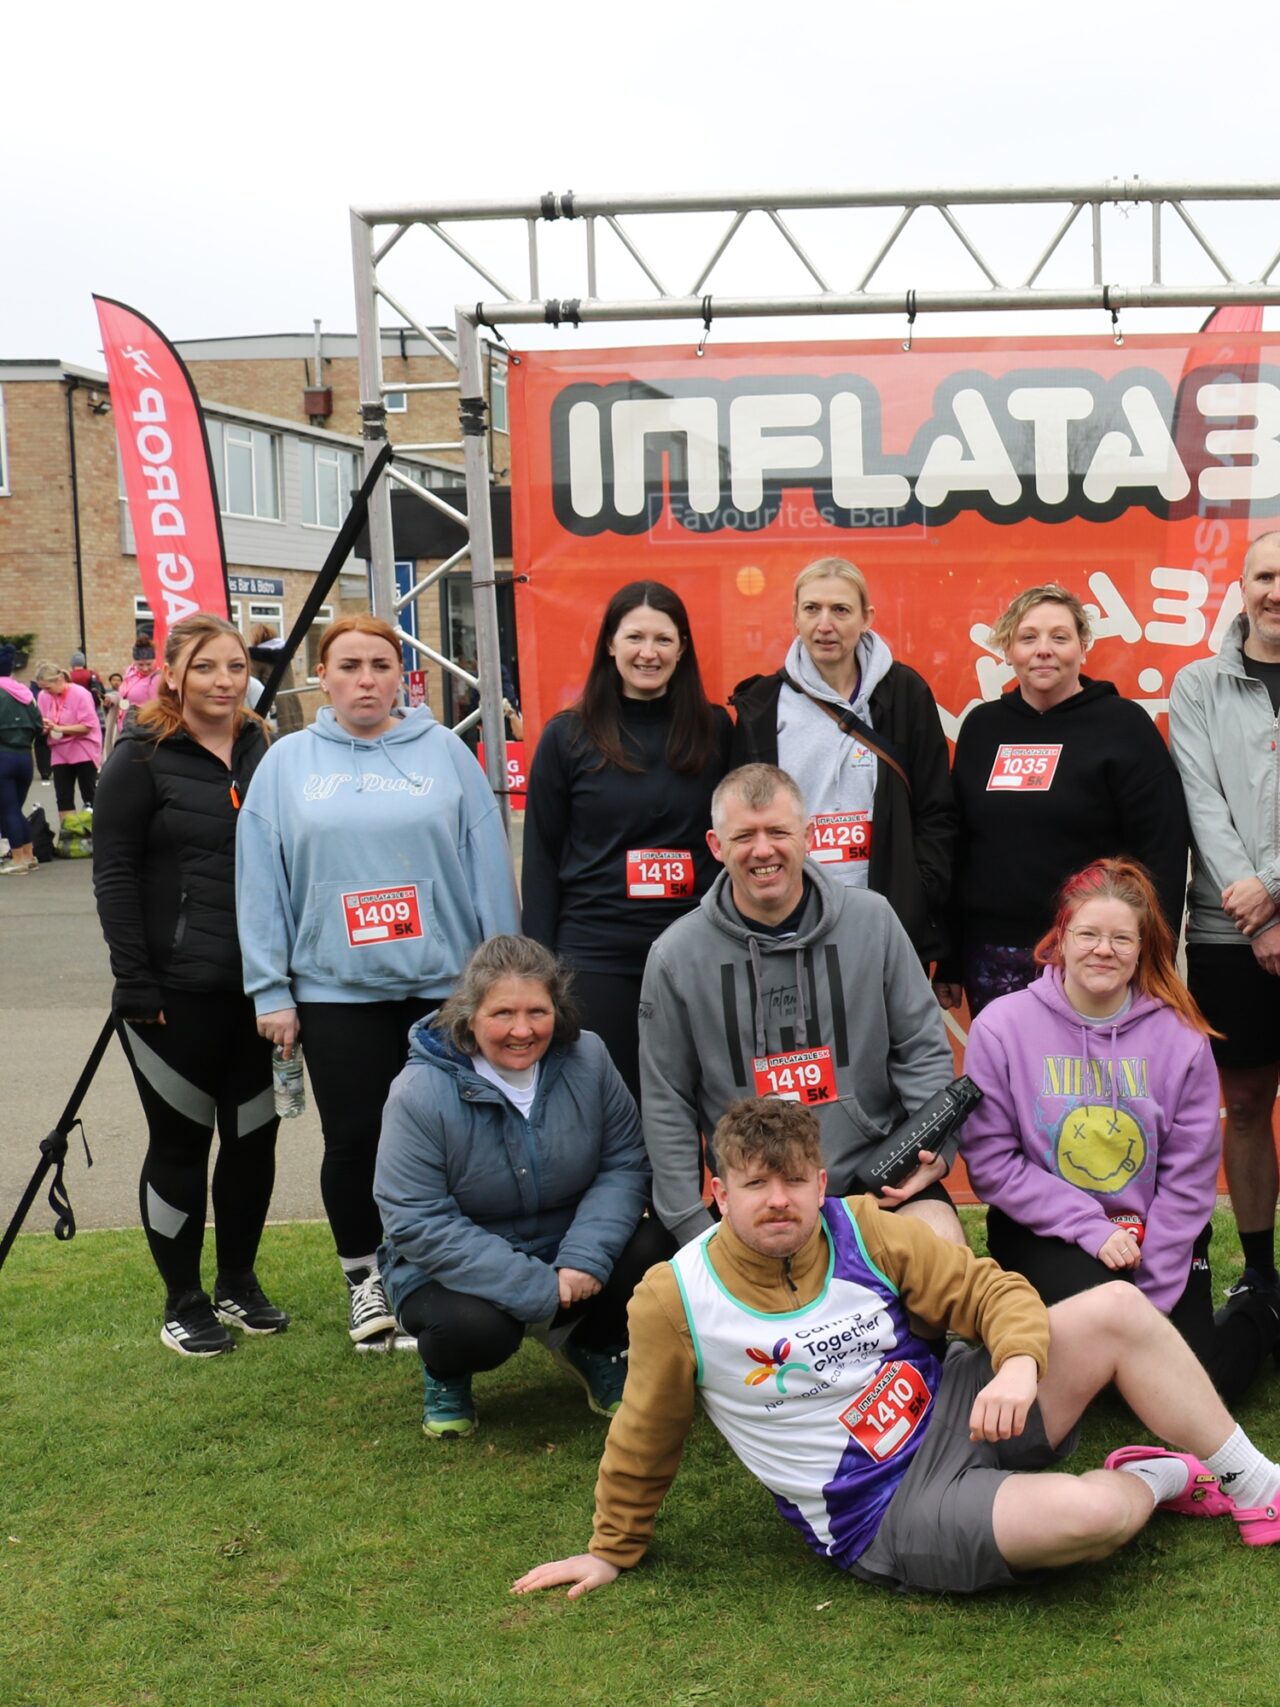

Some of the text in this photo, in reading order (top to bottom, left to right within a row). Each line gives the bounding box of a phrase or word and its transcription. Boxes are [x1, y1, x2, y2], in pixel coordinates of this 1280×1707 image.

[666, 502, 906, 530] Favourites Bar
[1002, 757, 1049, 775] 1035
[1027, 776, 1044, 786] 5K
[815, 825, 865, 848] 1426
[849, 846, 868, 859] 5K
[638, 862, 685, 881] 1413
[671, 883, 689, 895] 5K
[355, 901, 410, 926] 1409
[394, 922, 414, 935] 5K
[767, 1064, 821, 1091] 1419
[806, 1086, 830, 1102] 5K
[803, 1316, 880, 1357] Together
[866, 1378, 913, 1434] 1410
[908, 1392, 927, 1419] 5K
